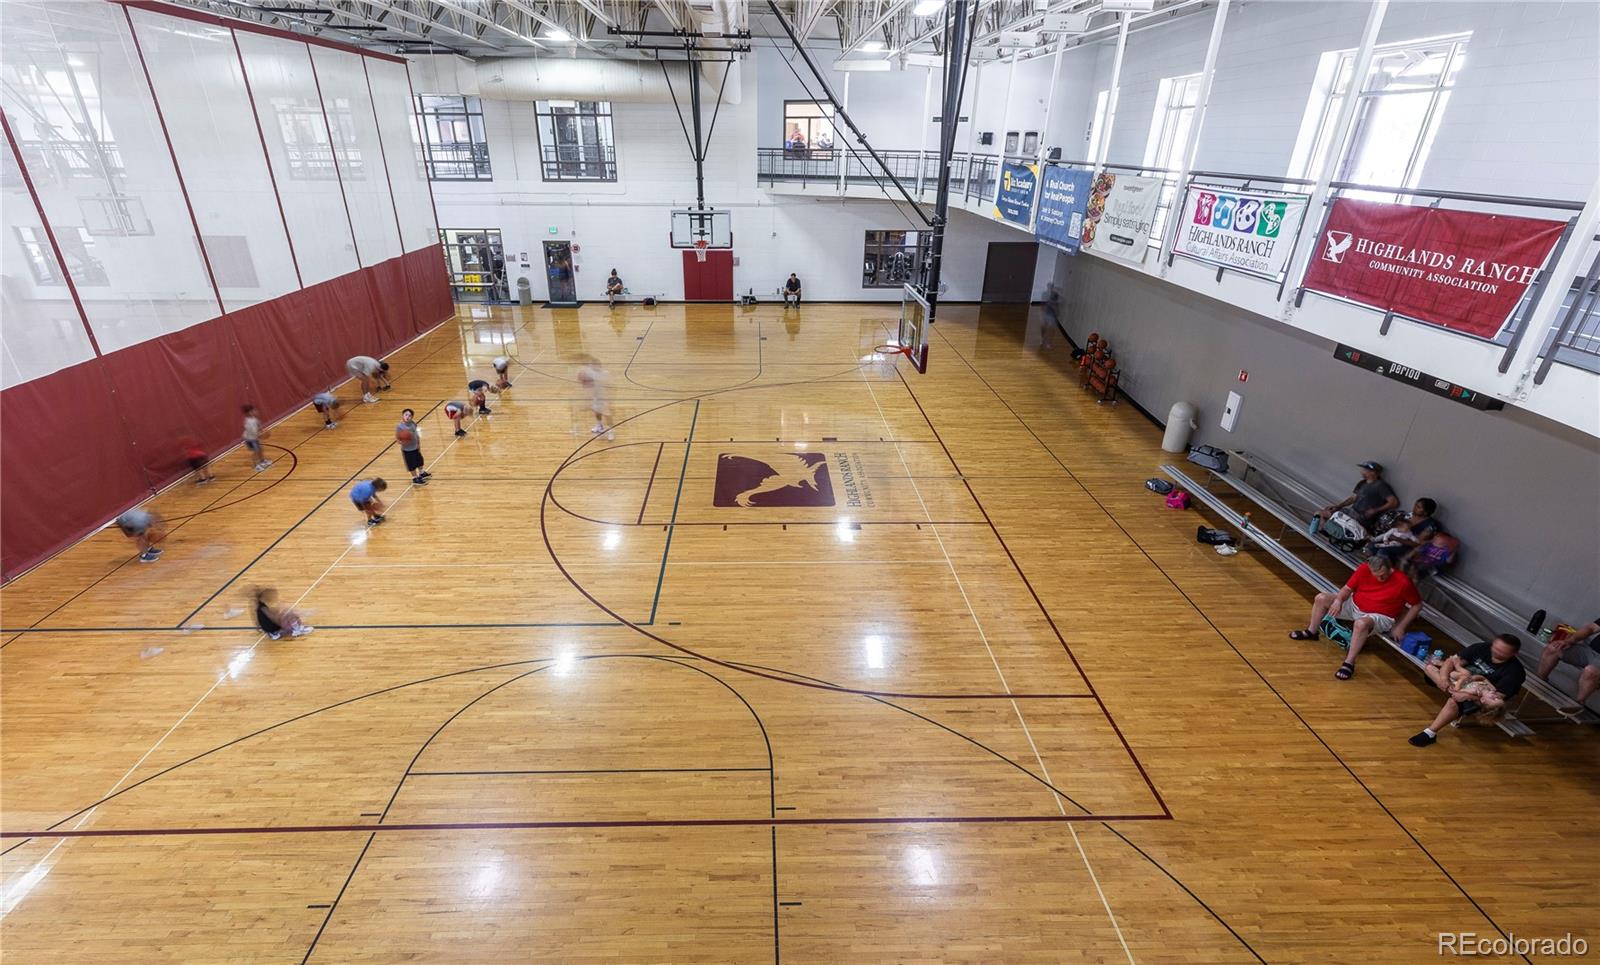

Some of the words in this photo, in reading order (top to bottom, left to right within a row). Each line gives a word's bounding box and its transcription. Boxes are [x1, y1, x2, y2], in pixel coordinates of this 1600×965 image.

[1059, 181, 1075, 192] Church
[1059, 193, 1075, 206] People
[1185, 241, 1209, 256] Cultural
[1208, 247, 1229, 262] Affairs
[1229, 253, 1269, 271] Association
[1189, 226, 1236, 252] HIGHLANDS
[1237, 239, 1275, 258] RANCH
[1355, 237, 1456, 270] HIGHLANDS
[1459, 257, 1539, 285] RANCH
[1369, 259, 1426, 280] COMMUNITY
[1425, 271, 1499, 295] ASSOCIATION
[1389, 362, 1421, 381] period
